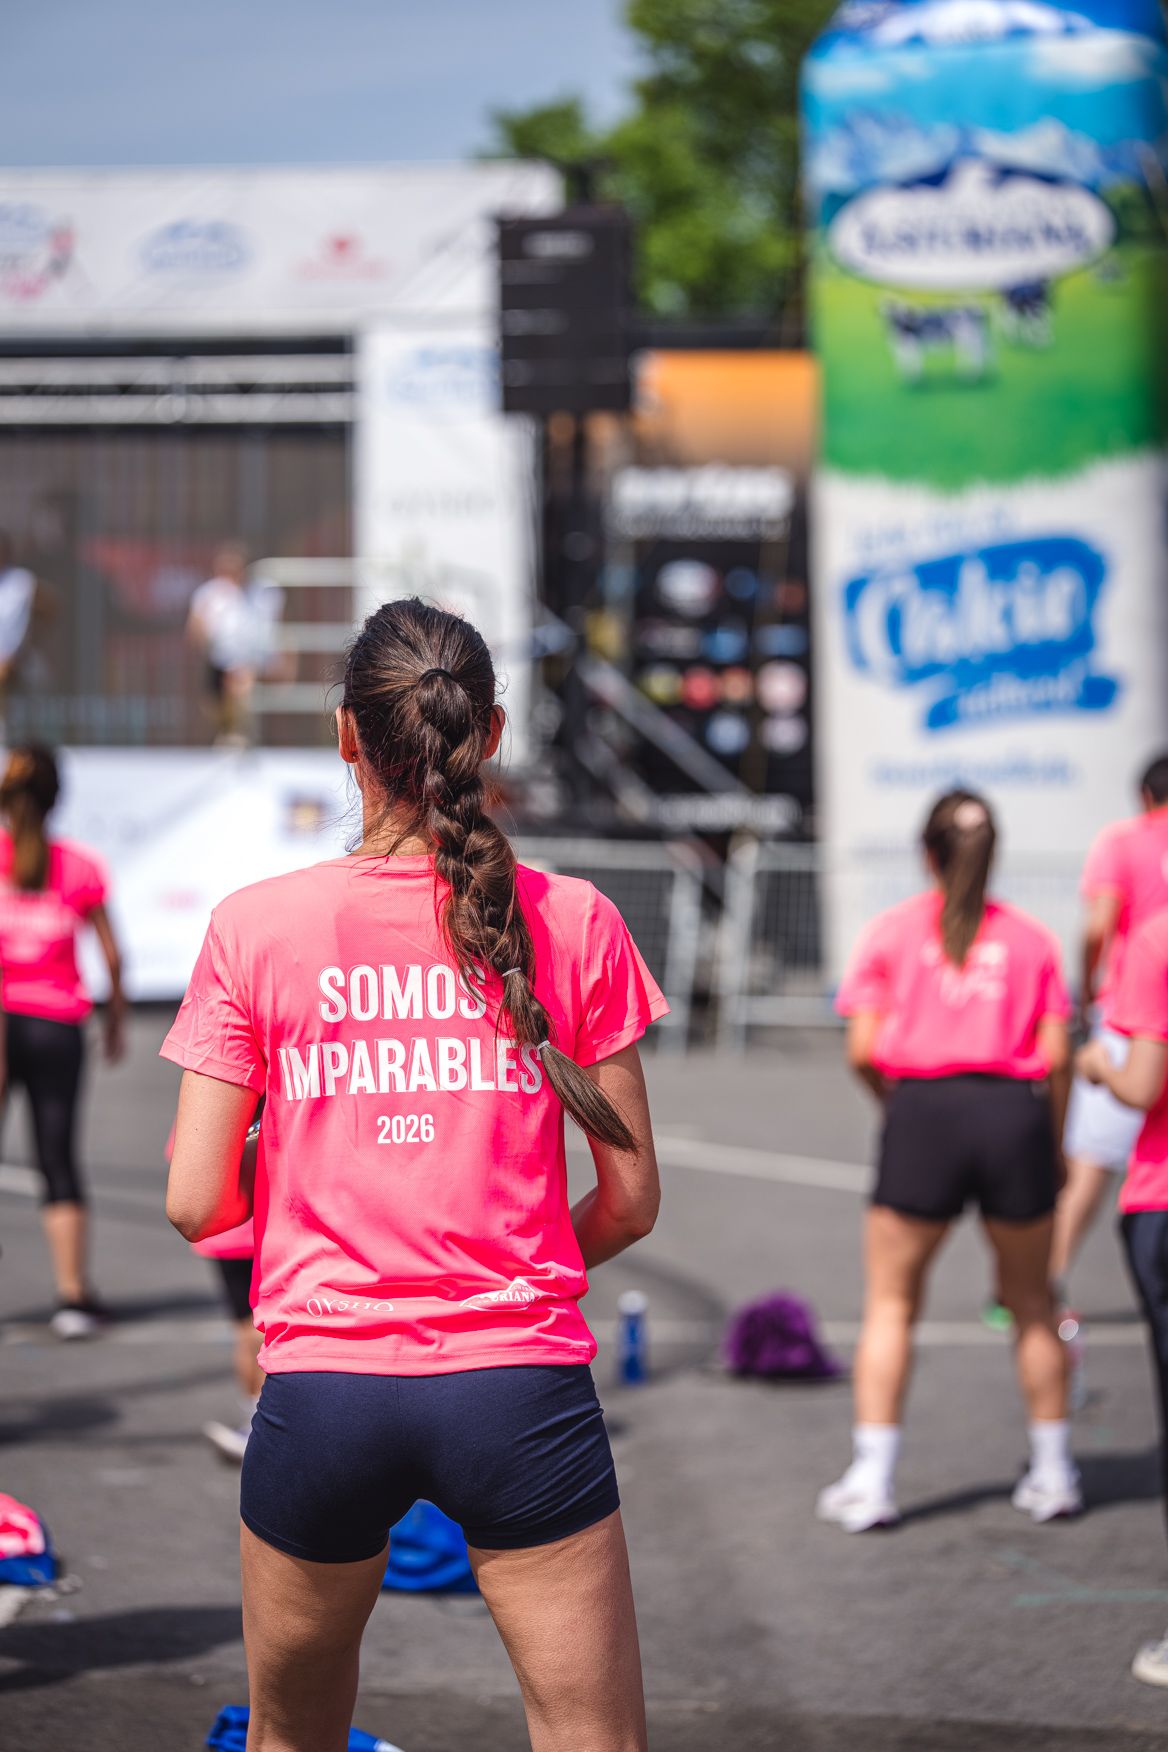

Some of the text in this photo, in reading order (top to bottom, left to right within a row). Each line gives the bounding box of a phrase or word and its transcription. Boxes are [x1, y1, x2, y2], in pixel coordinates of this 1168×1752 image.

[318, 964, 487, 1023] SOMOS
[277, 1037, 543, 1100] IMPARABLES
[377, 1113, 435, 1144] 2026
